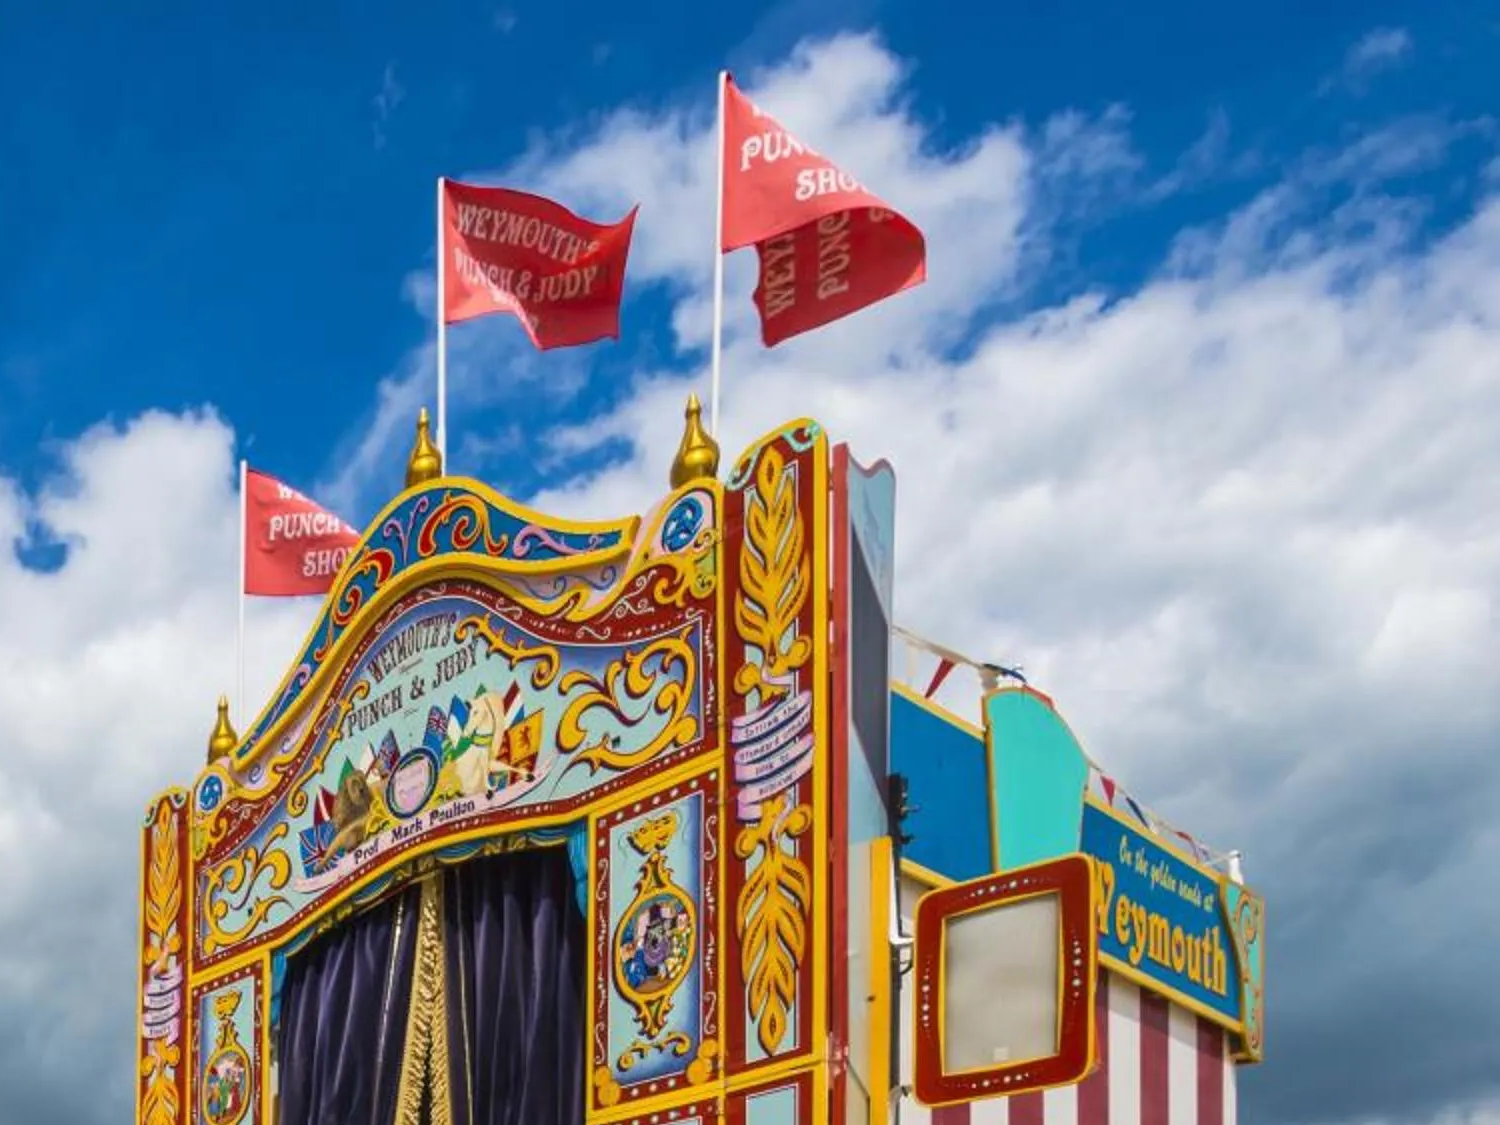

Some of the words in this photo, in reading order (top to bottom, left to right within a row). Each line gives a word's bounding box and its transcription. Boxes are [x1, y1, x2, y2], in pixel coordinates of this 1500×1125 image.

[740, 131, 818, 172] PUN
[796, 167, 869, 201] SHO
[457, 203, 600, 266] WEYMOUTH'S
[516, 270, 533, 300] &
[534, 266, 598, 304] JUDY
[302, 547, 354, 577] SHO
[348, 684, 403, 737] PUNCH
[410, 675, 425, 701] &
[432, 637, 479, 689] JUDY
[391, 818, 425, 843] Mark
[429, 800, 476, 826] Poulton
[1120, 834, 1132, 867] On
[1135, 847, 1149, 878] the
[1151, 859, 1177, 893] golden
[1179, 878, 1202, 909] sands
[1203, 892, 1216, 914] at
